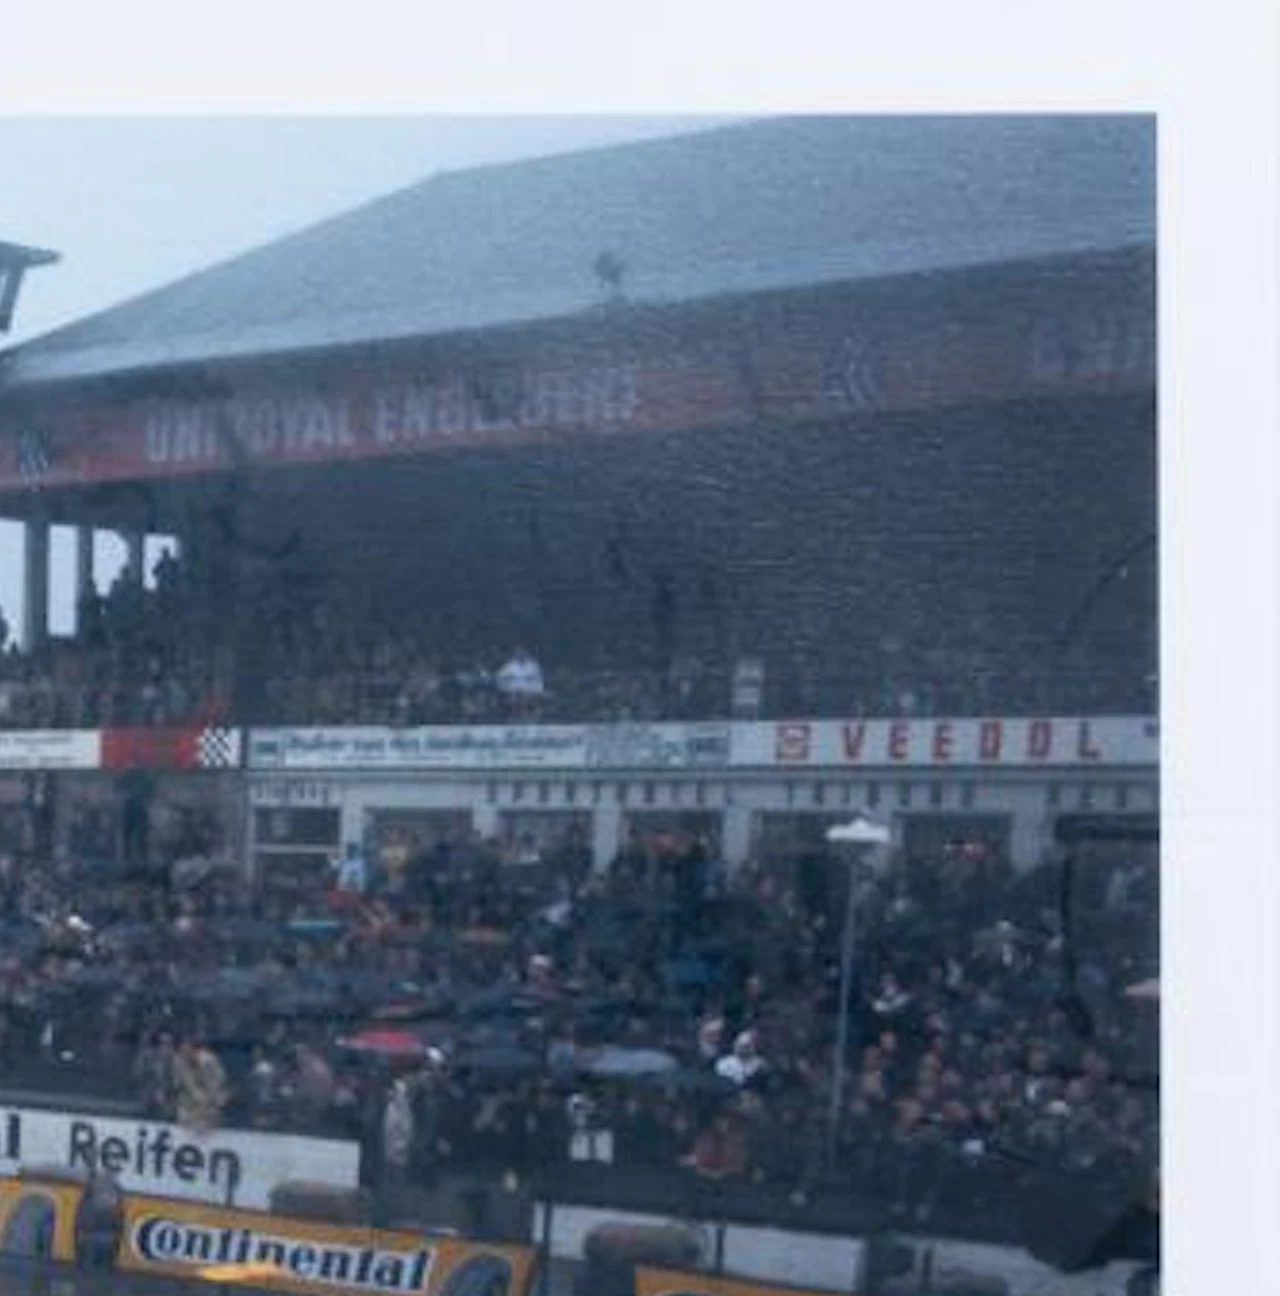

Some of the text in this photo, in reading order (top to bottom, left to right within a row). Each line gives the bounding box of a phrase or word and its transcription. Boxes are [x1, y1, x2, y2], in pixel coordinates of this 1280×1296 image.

[843, 721, 1100, 762] VEEDOL
[69, 1121, 239, 1188] Reifen
[138, 1215, 432, 1291] Continental
